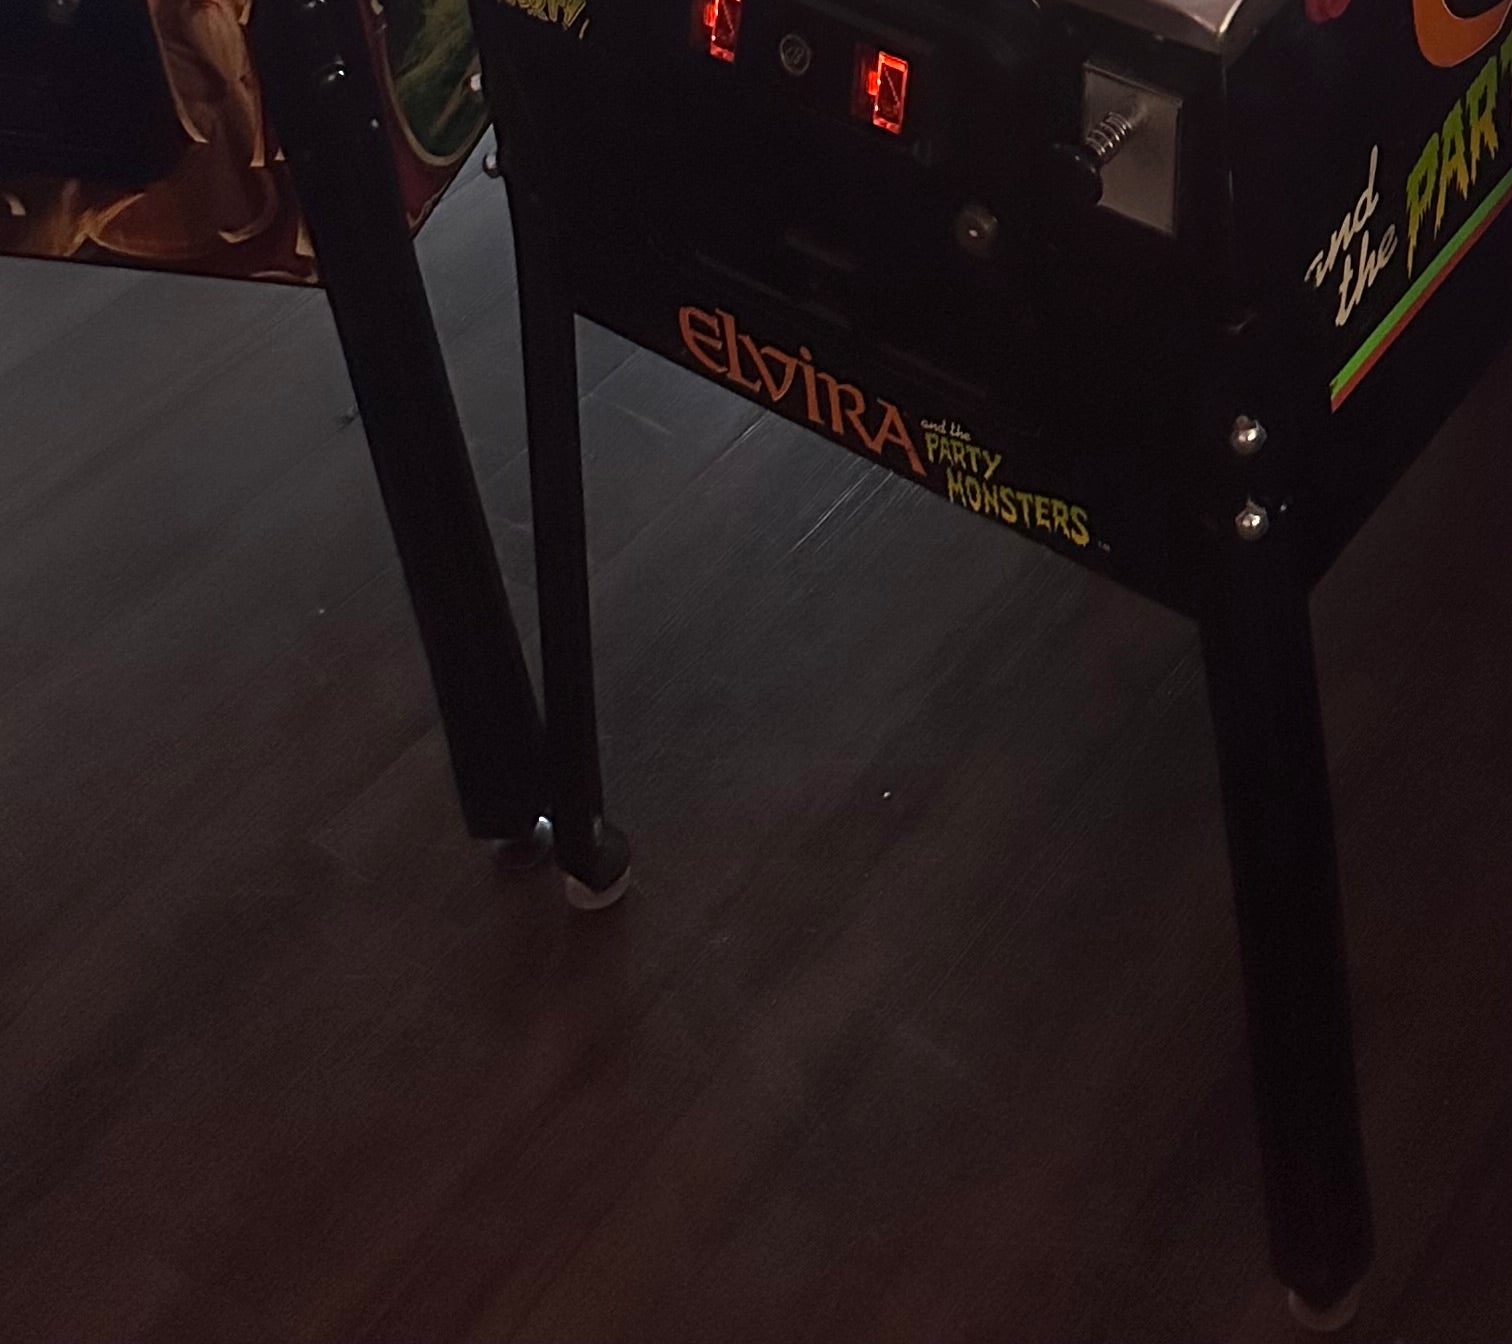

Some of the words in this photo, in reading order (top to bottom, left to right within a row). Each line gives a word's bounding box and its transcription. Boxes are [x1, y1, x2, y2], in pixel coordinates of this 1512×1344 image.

[1334, 223, 1400, 327] the
[920, 417, 947, 435] and
[948, 419, 971, 442] the
[923, 431, 1002, 481] PARTY
[946, 466, 1091, 549] MONSTERS
